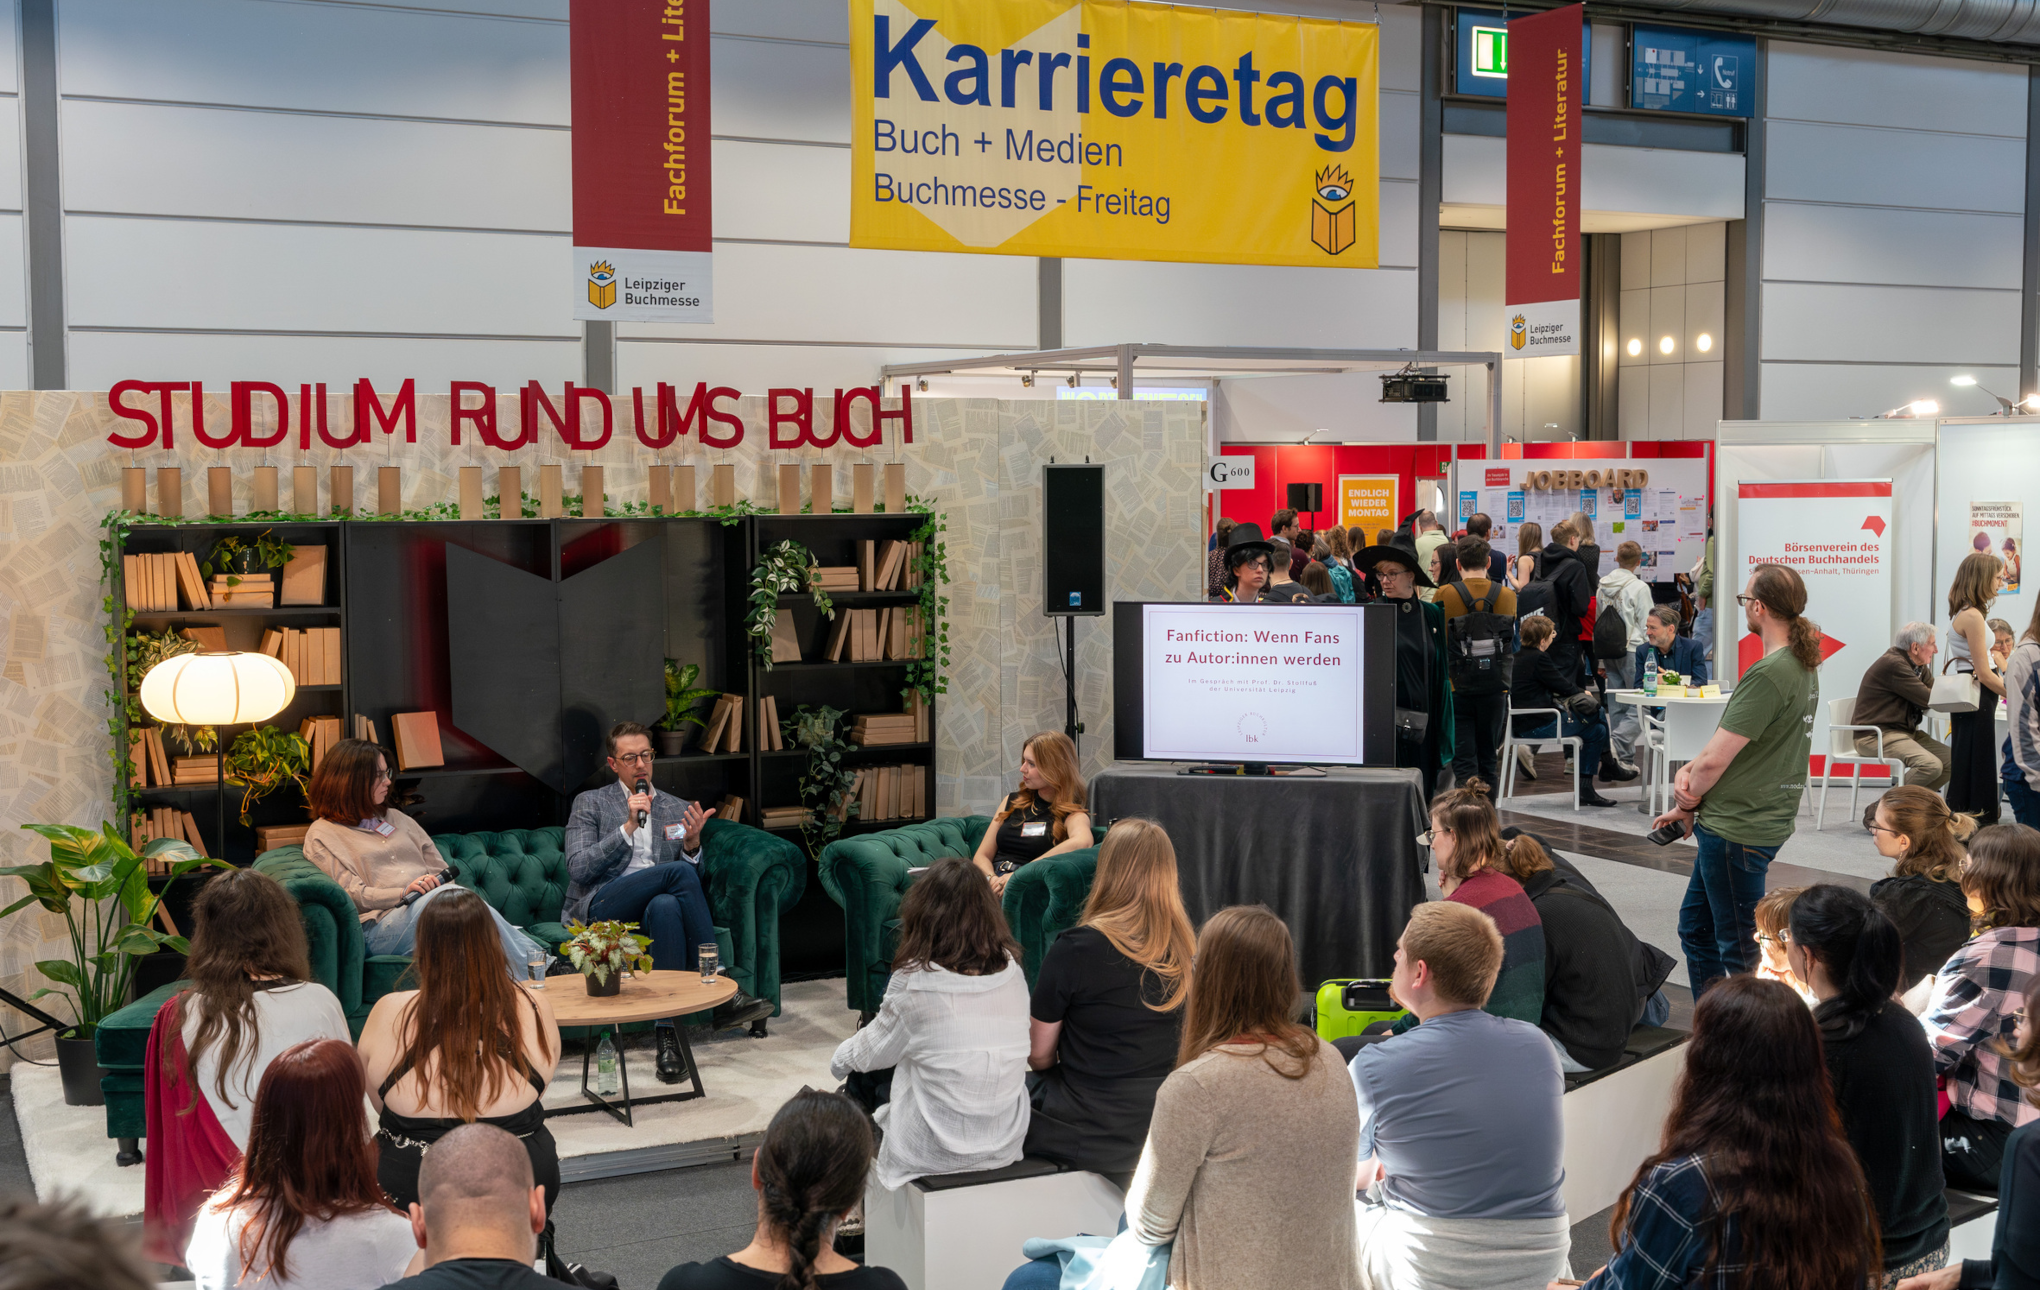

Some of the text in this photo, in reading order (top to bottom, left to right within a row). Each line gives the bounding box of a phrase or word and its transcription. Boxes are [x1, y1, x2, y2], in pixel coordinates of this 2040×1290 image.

[666, 49, 679, 63] +
[874, 14, 1358, 152] Karrieretag
[664, 71, 686, 215] Fachforum
[874, 119, 1123, 166] Buch + Medien
[1552, 49, 1567, 274] Fachforum + Literatur
[874, 172, 1046, 210] Buchmesse
[1077, 184, 1170, 224] Freitag
[624, 277, 686, 293] Leipziger
[624, 292, 700, 307] Buchmesse
[1530, 322, 1563, 334] Leipziger
[1530, 333, 1571, 346] Buchmesse
[106, 378, 913, 450] STUDIUM RUND UMS BUCH
[1210, 462, 1250, 482] G 600
[1520, 468, 1648, 490] JOBBOARD
[1784, 542, 1879, 552] Börsenverein des
[1749, 555, 1879, 564] Deutschen Buchhandels
[1843, 568, 1879, 576] Thüringen
[1167, 629, 1340, 644] Fanfiction: Wenn Fans
[1165, 652, 1341, 666] zu Autor:innen werden
